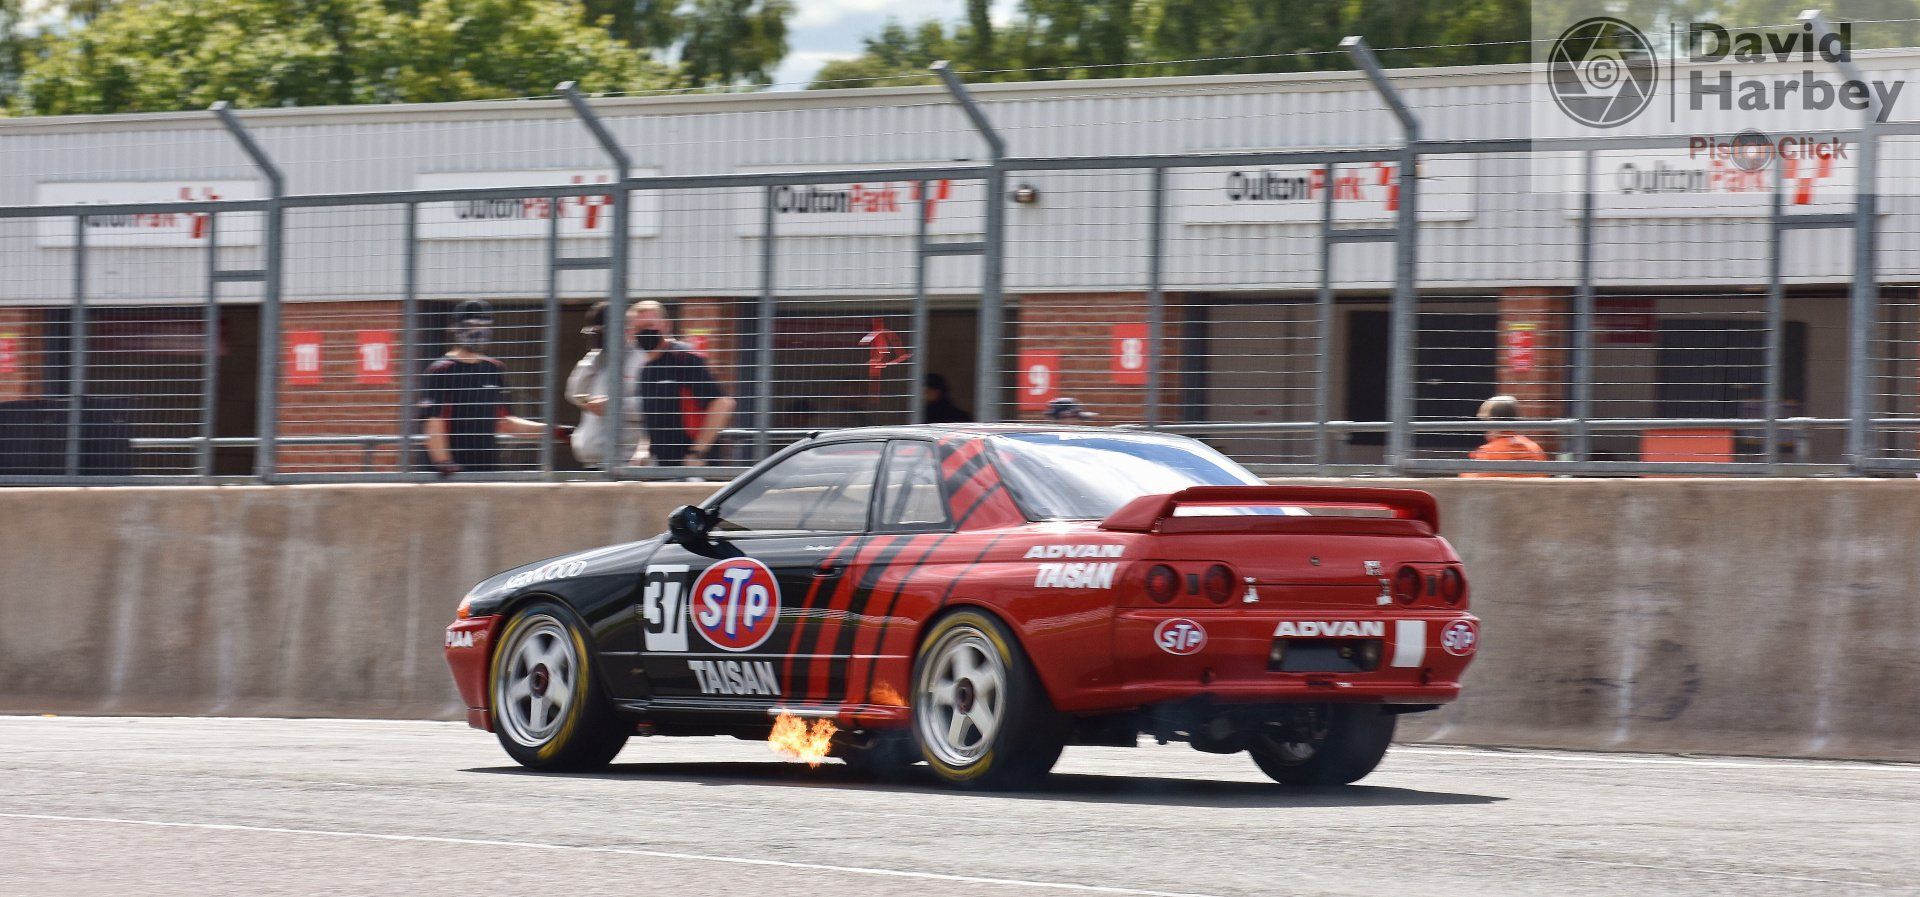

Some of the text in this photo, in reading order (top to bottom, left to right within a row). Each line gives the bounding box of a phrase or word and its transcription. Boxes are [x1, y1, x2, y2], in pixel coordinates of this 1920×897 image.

[1226, 168, 1365, 201] OultonPrk
[293, 343, 319, 371] 11
[360, 343, 388, 371] 10
[1120, 338, 1143, 369] 8
[1028, 364, 1050, 396] 9
[1024, 545, 1127, 559] ADVAN
[1034, 562, 1119, 589] TAISAN
[644, 571, 689, 634] 37
[699, 567, 770, 639] STP
[1160, 623, 1204, 651] STP
[1273, 620, 1385, 637] ADVAN
[1444, 623, 1476, 650] STP
[687, 659, 782, 696] TAISAN
